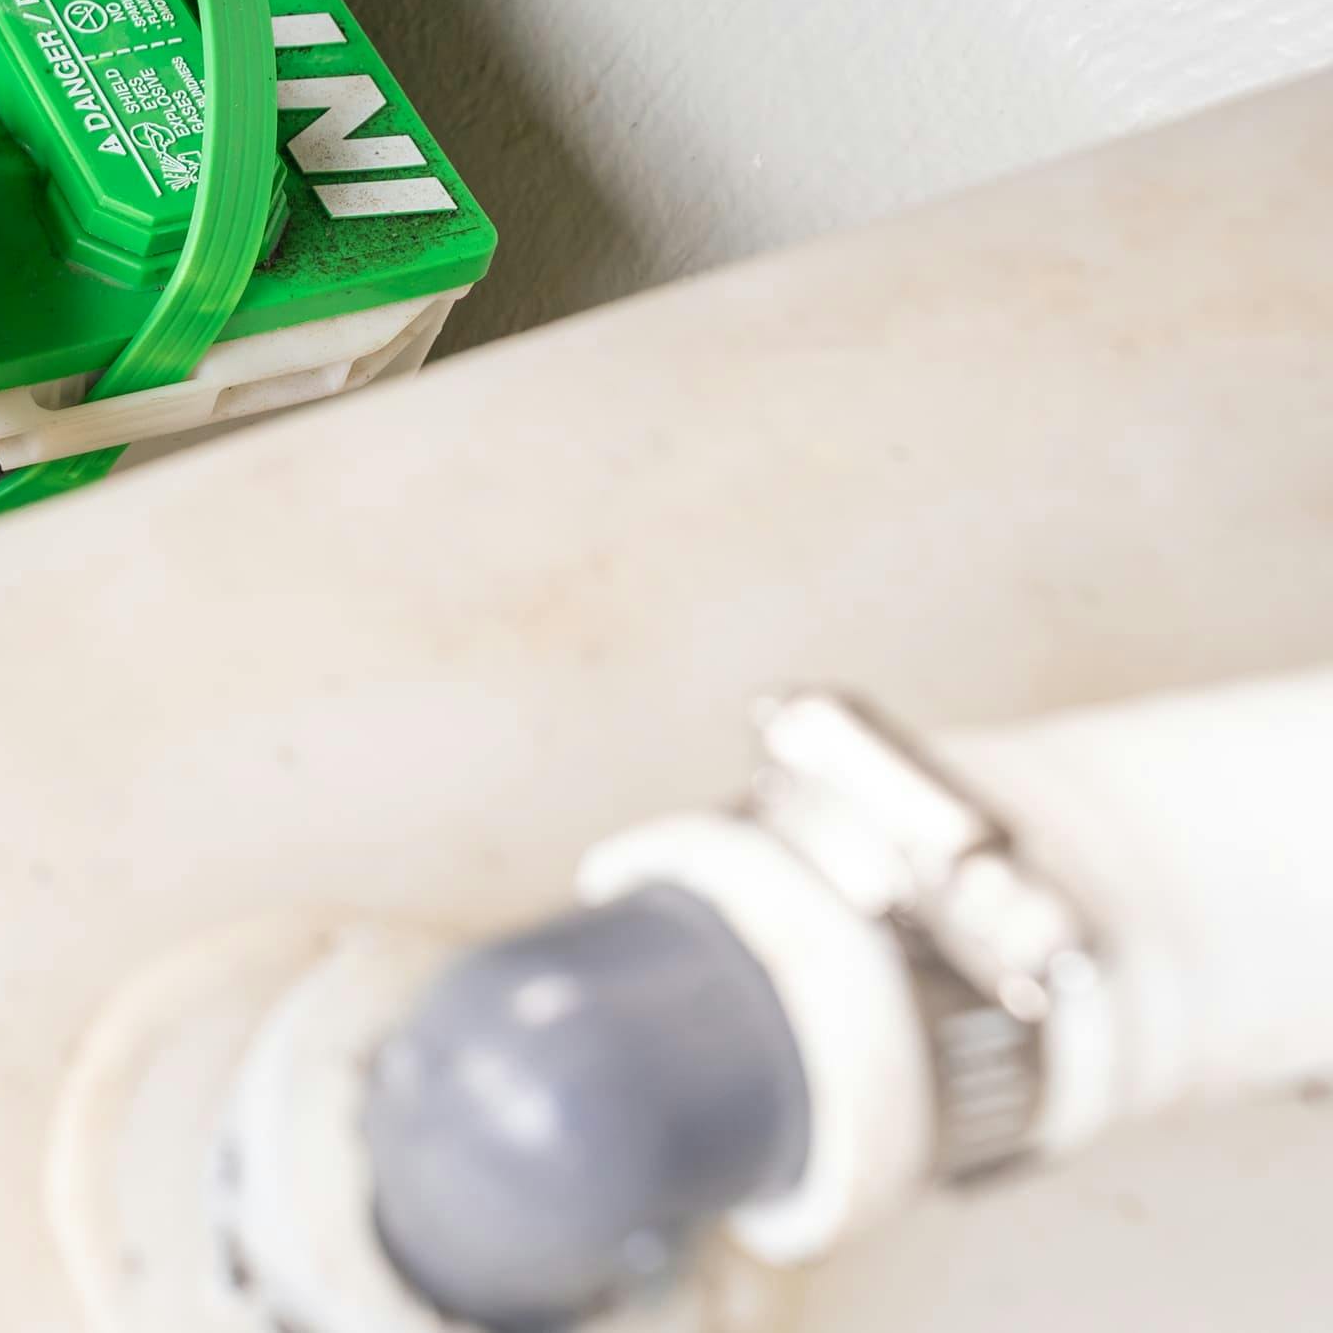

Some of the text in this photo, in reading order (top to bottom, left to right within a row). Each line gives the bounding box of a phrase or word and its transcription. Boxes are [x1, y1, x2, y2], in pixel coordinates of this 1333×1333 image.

[105, 1, 126, 22] NO
[37, 30, 109, 130] DANGER
[105, 68, 140, 113] SHIELD
[128, 76, 157, 110] EYES
[139, 68, 190, 137] EXPLOSIVE
[172, 89, 207, 133] GASES
